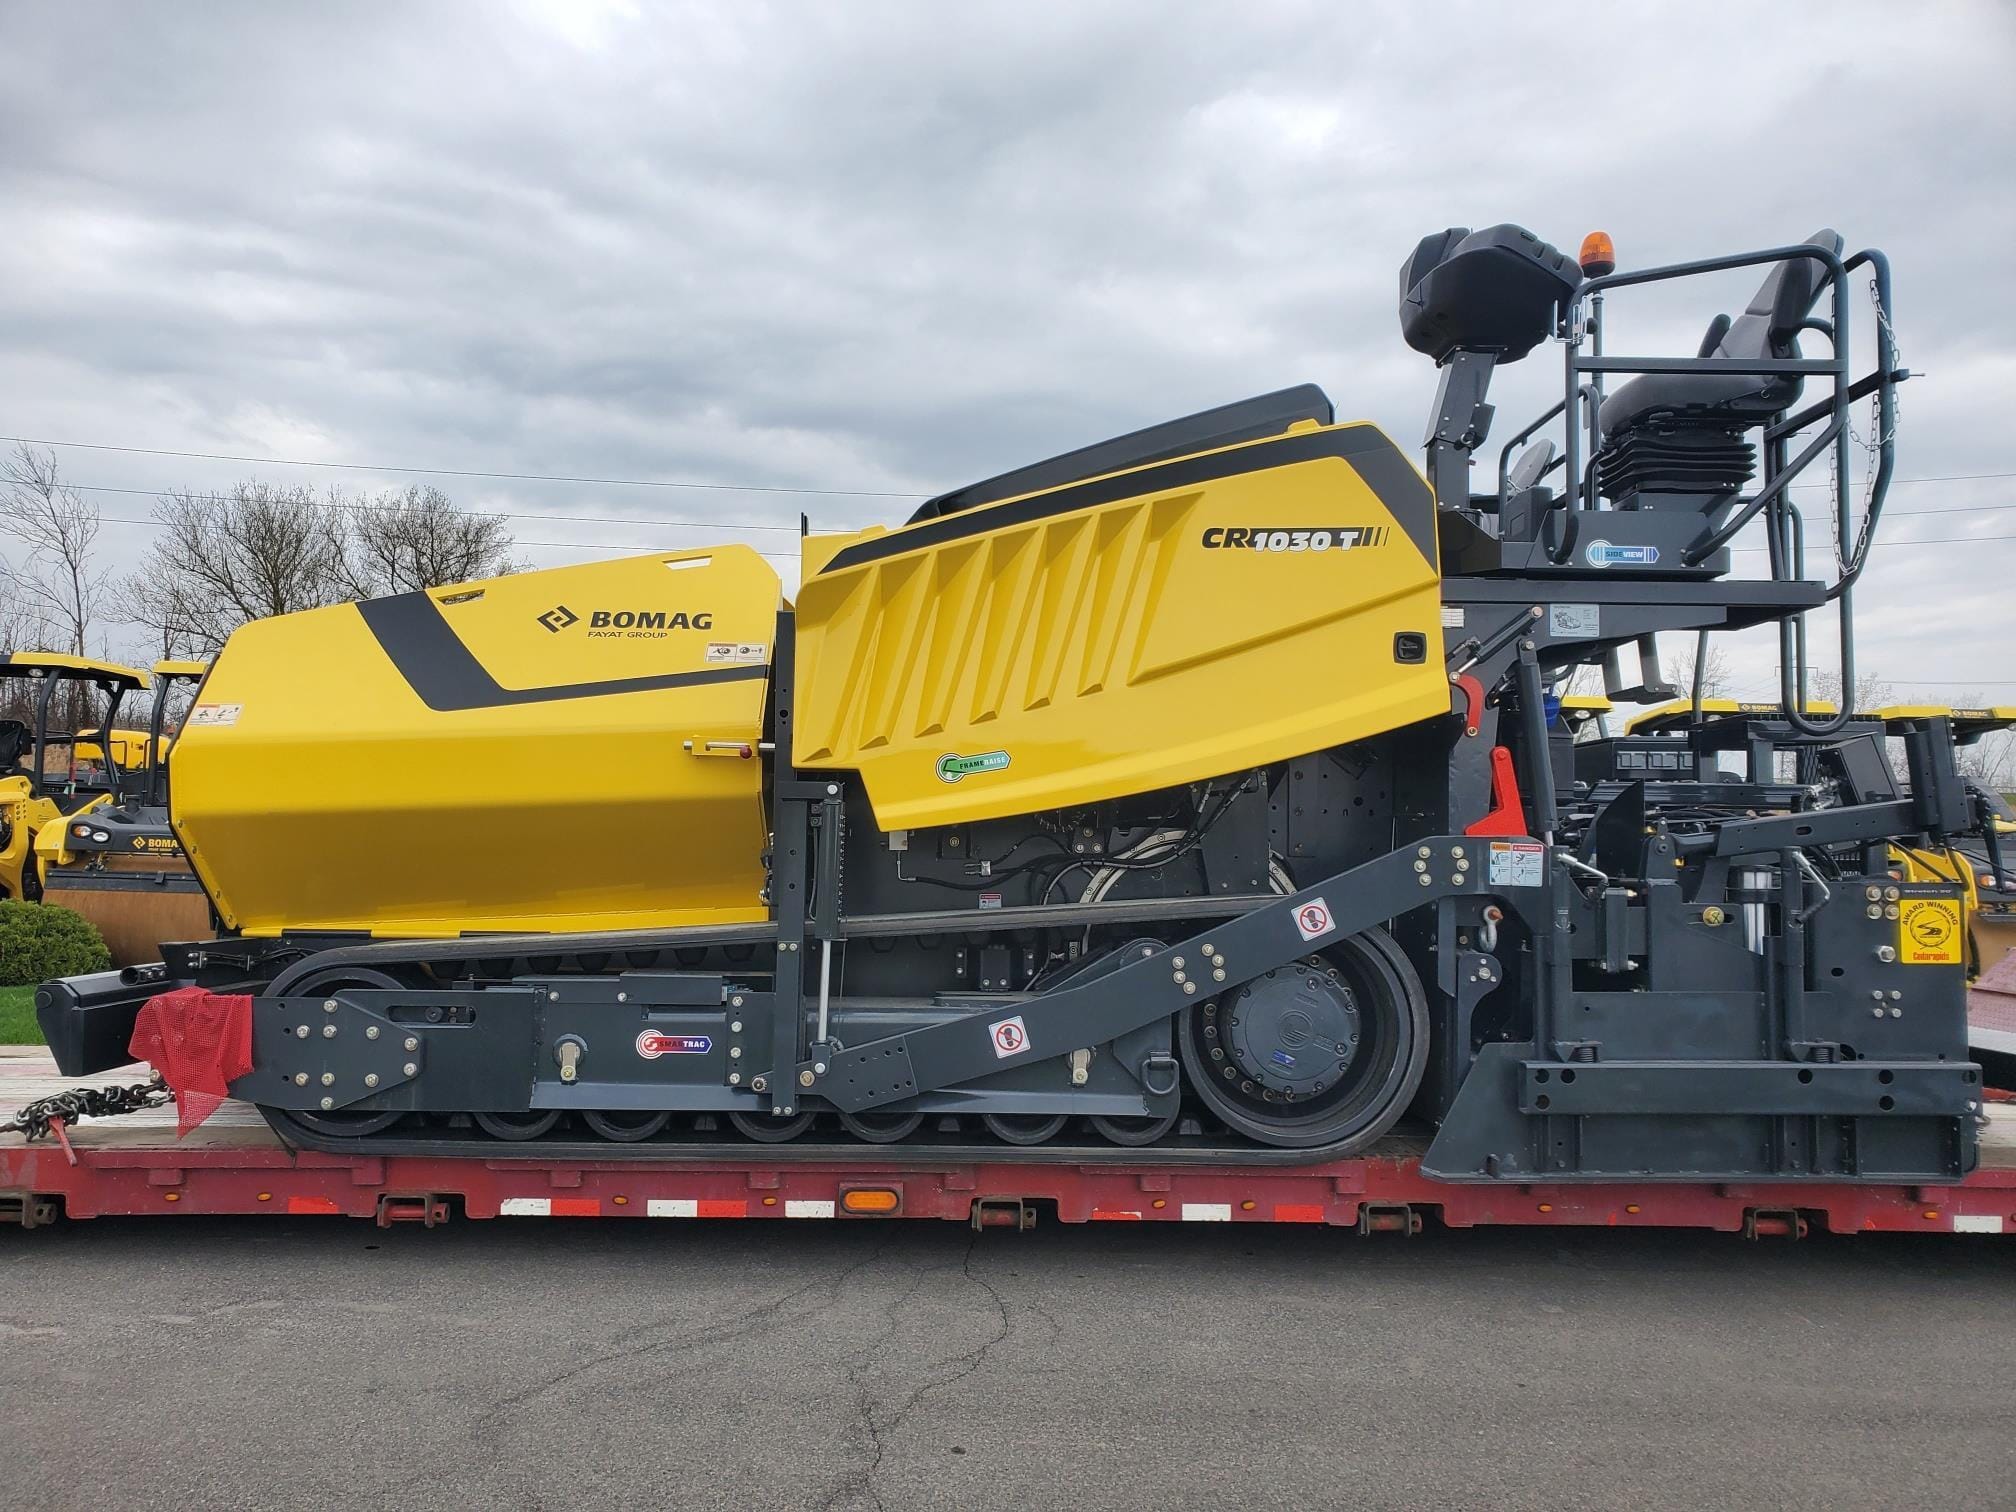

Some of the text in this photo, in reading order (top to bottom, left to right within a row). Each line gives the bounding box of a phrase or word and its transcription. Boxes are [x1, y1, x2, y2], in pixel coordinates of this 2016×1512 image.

[1202, 527, 1360, 552] CR1030 T
[590, 611, 713, 630] BOMAG
[627, 631, 668, 639] GROUP
[959, 756, 1007, 770] FRAMERAISE
[148, 838, 179, 848] BOMA
[1902, 901, 1959, 926] AWARD WINNING
[659, 1040, 706, 1048] SMARTRAC
